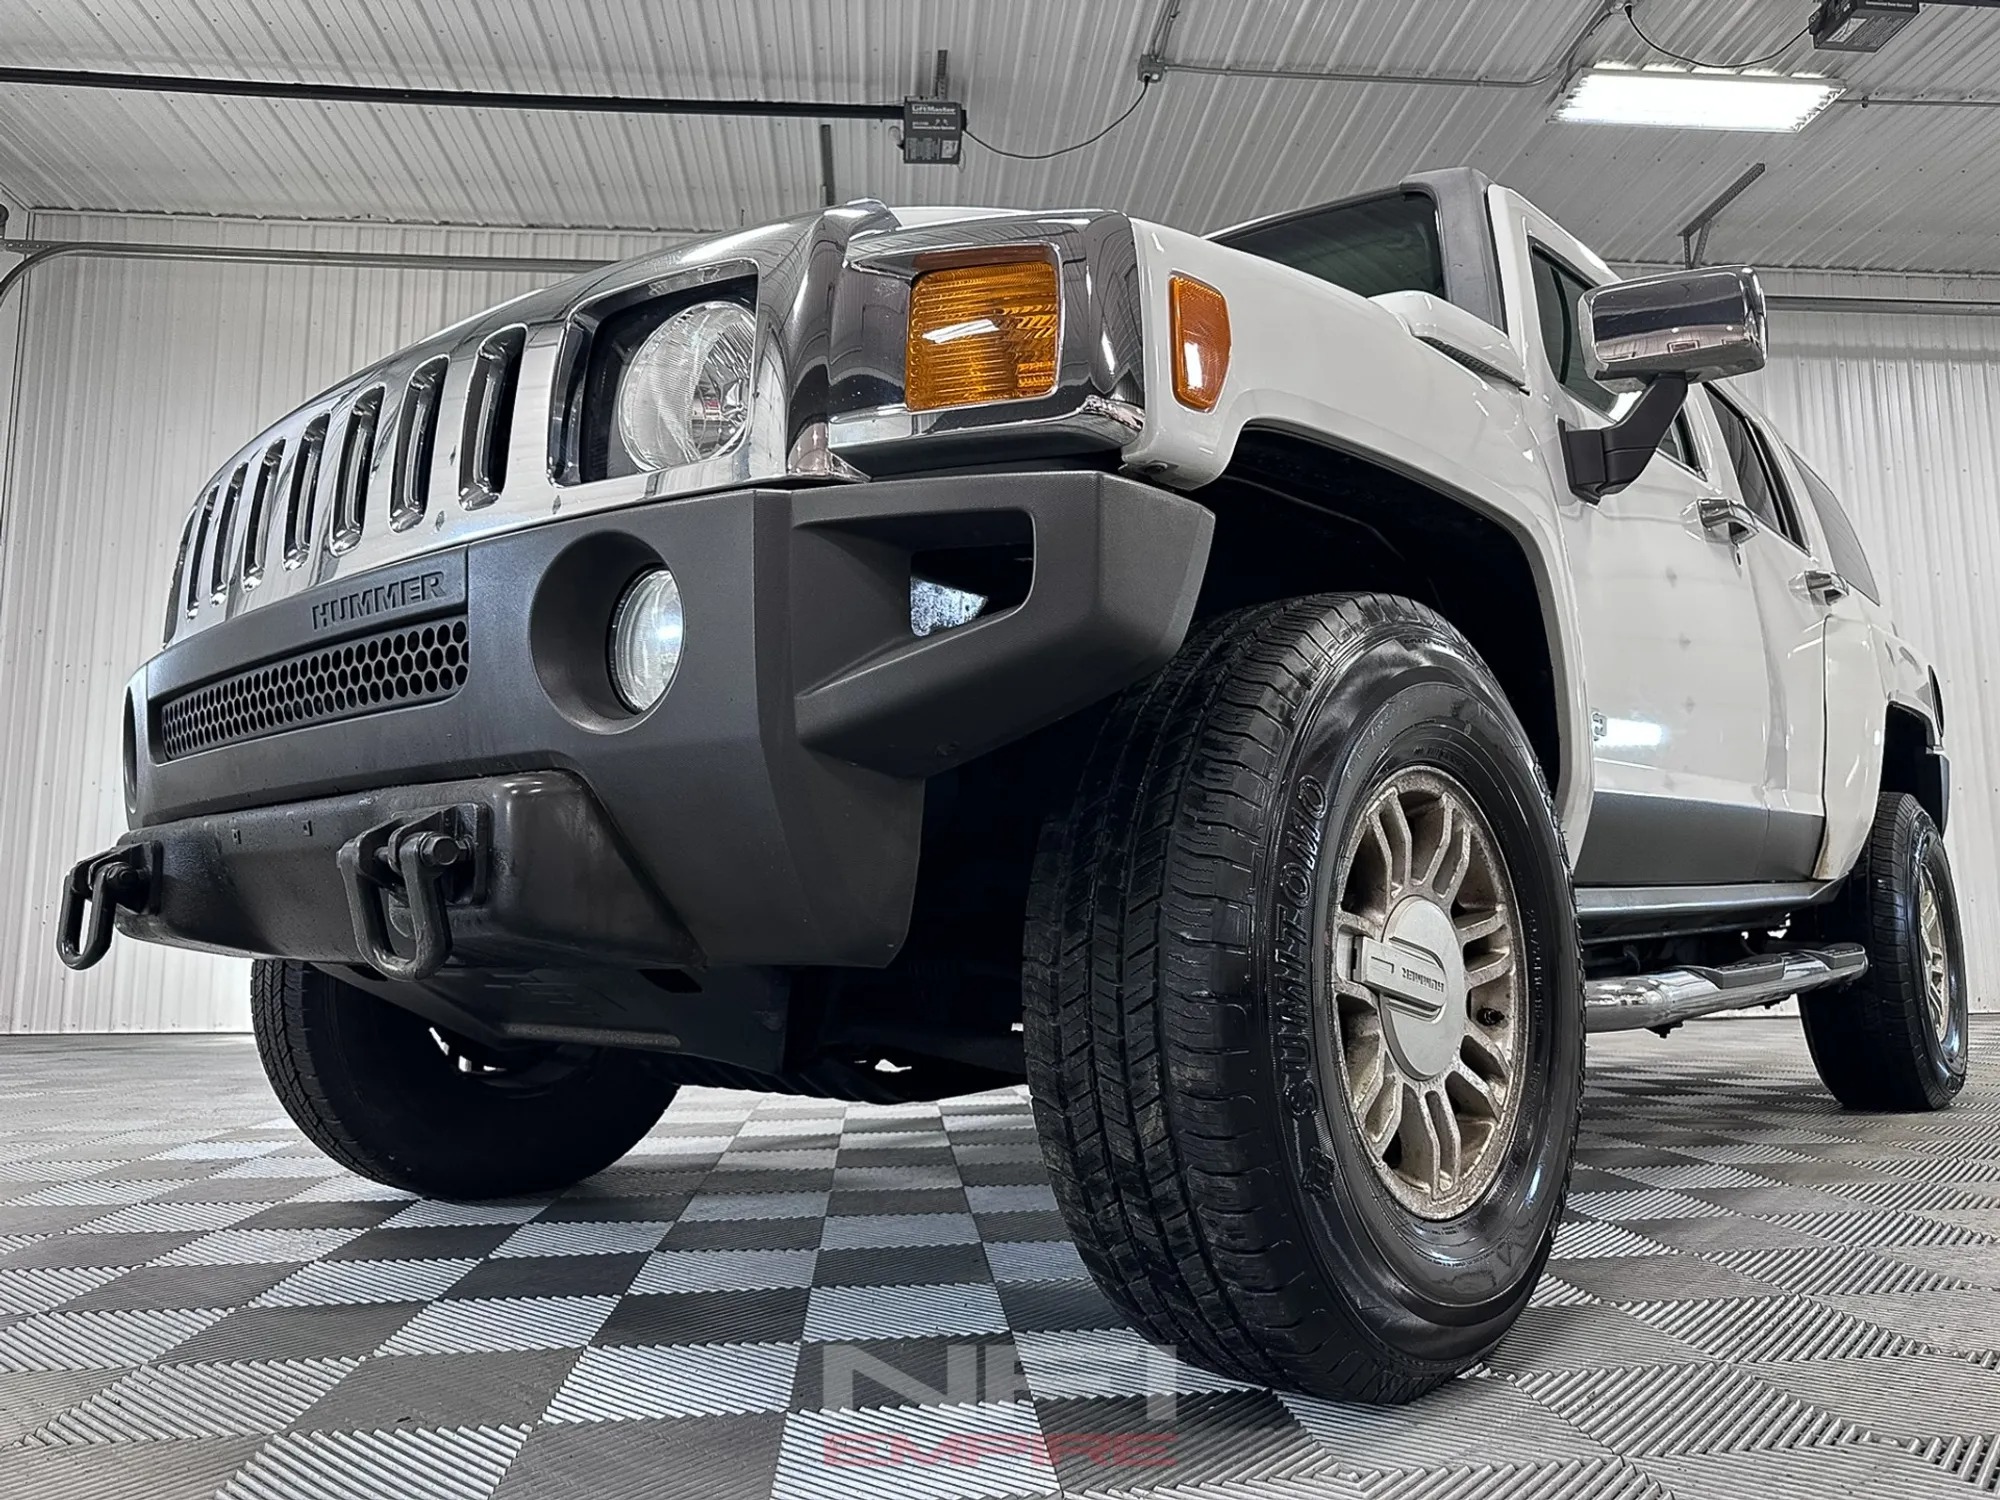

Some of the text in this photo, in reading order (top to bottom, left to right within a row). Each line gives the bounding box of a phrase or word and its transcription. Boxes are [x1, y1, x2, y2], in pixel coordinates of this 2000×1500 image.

[312, 570, 447, 630] HUMMER
[1274, 773, 1328, 1118] SUMITOMO
[1401, 966, 1445, 993] HUMMER
